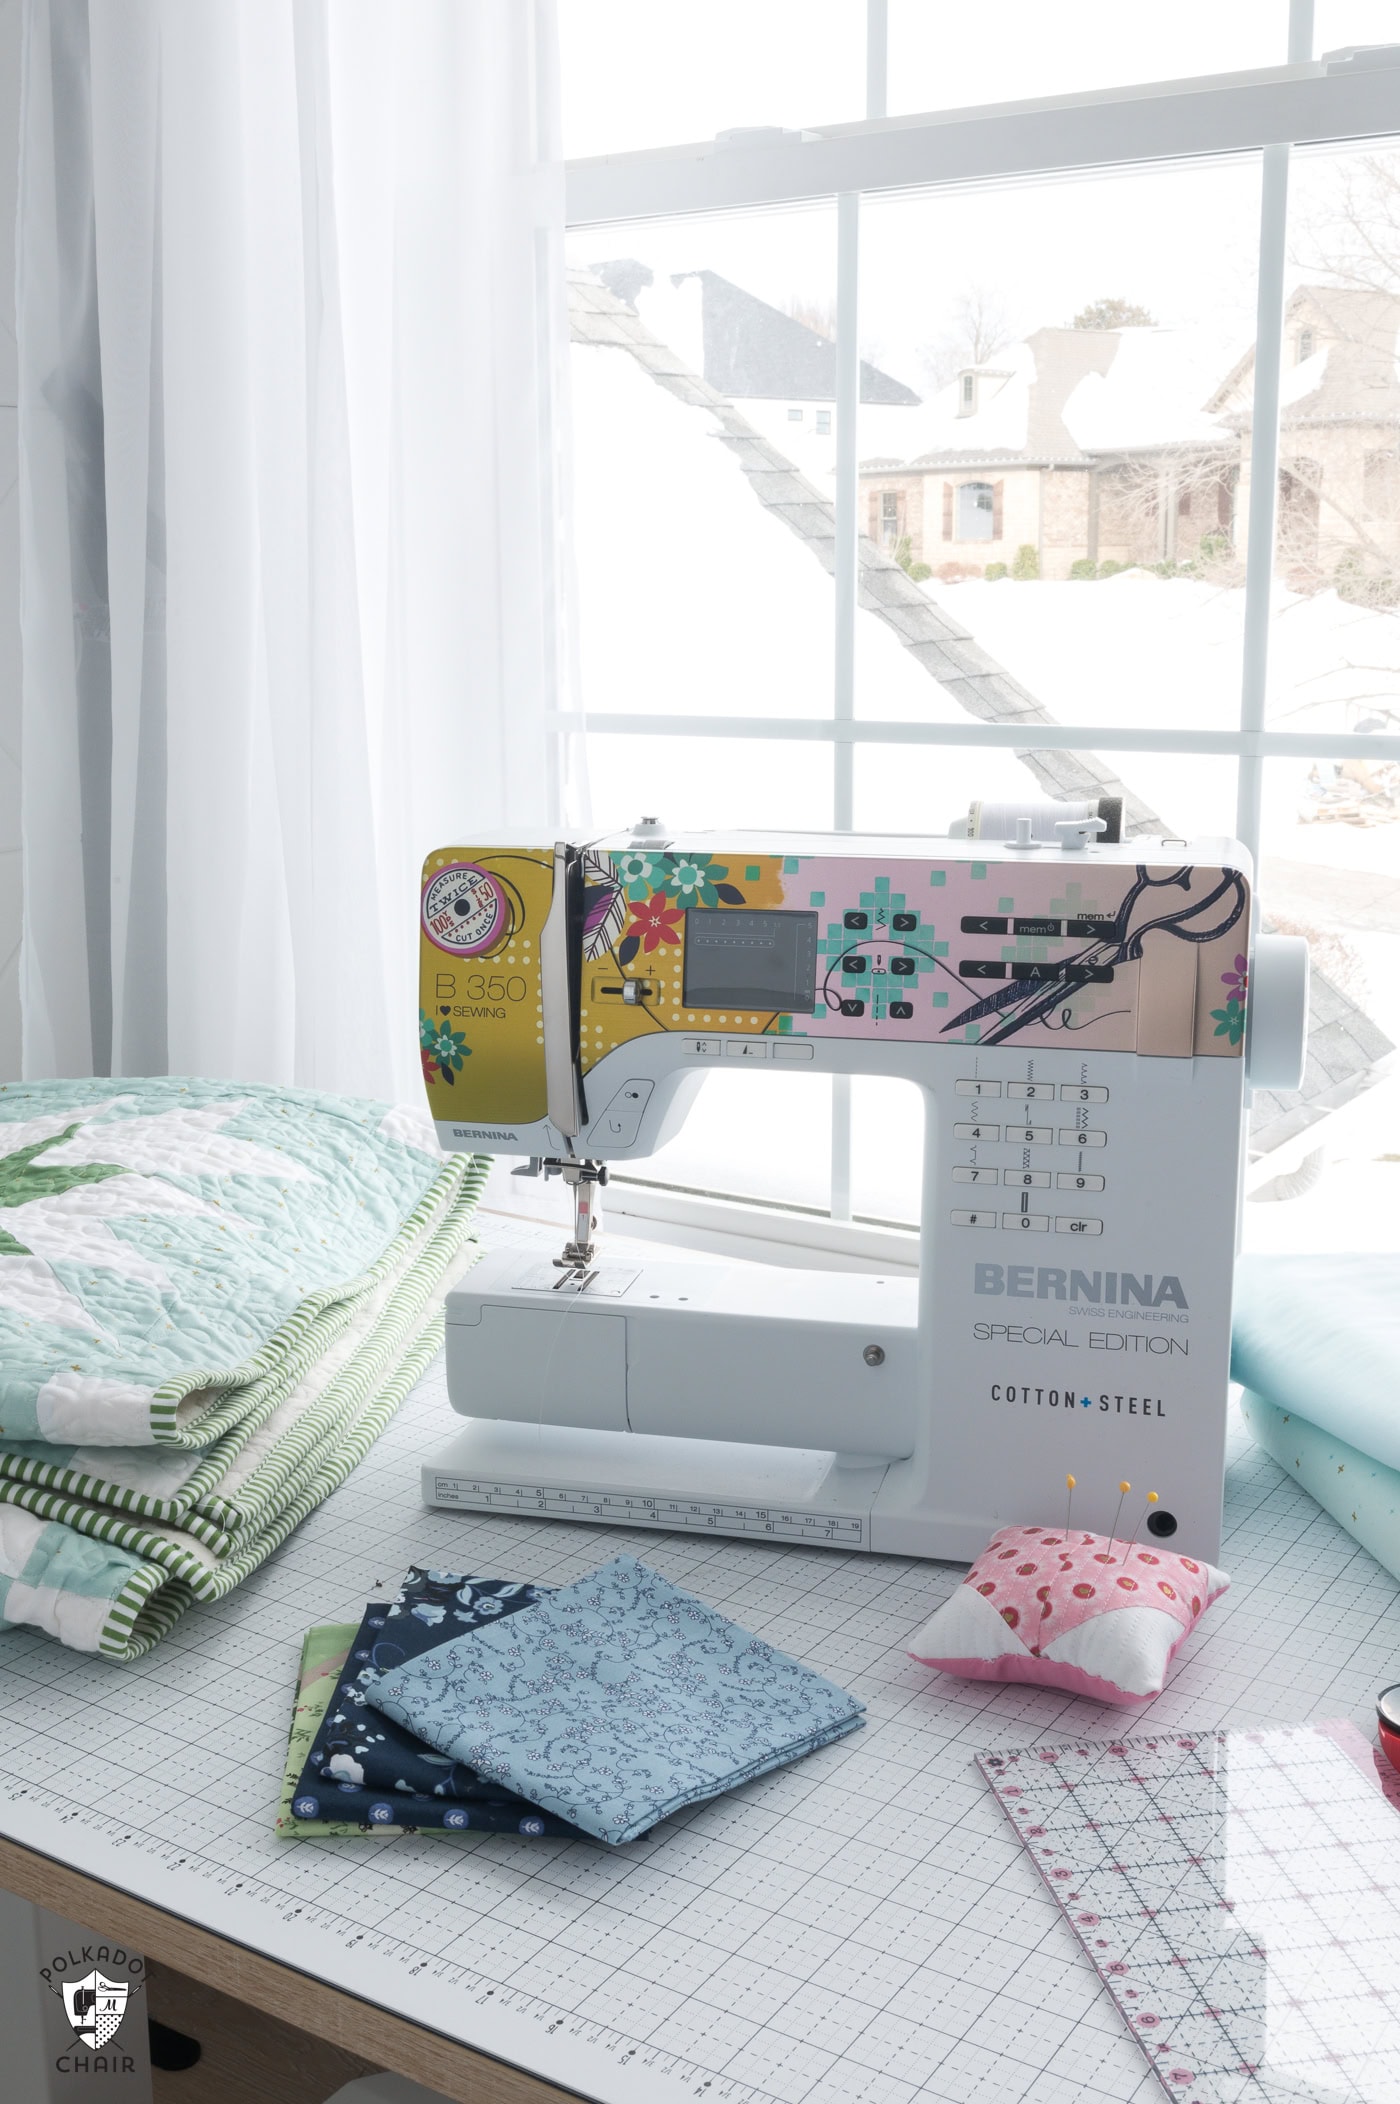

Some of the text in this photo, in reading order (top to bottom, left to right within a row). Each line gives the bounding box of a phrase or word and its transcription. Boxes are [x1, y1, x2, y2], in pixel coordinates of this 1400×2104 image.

[430, 872, 468, 900] MEASURE
[430, 876, 477, 912] TWICE
[478, 882, 494, 901] 50
[430, 915, 449, 935] 100
[456, 912, 493, 942] CUT ONCE
[1020, 925, 1047, 934] mem
[1030, 966, 1040, 977] A
[436, 973, 527, 1002] B 350
[453, 1005, 506, 1019] SEWING
[975, 1084, 1089, 1101] 1 2 3
[453, 1128, 518, 1141] BERNINA
[971, 1128, 1087, 1145] 4 5 6
[971, 1171, 1085, 1188] 7 8 9
[1021, 1217, 1030, 1228] 0
[1070, 1221, 1087, 1233] clr
[974, 1262, 1189, 1310] BERNINA
[1069, 1305, 1189, 1323] SWISS ENGINEERING
[973, 1322, 1189, 1356] SPECIAL EDITION
[438, 1492, 459, 1500] inches
[538, 1500, 544, 1508] 2
[594, 1506, 600, 1514] 3
[707, 1517, 714, 1525] 5
[766, 1523, 772, 1531] 6
[825, 1529, 831, 1537] 7
[642, 1500, 653, 1508] 10
[756, 1511, 766, 1519] 15
